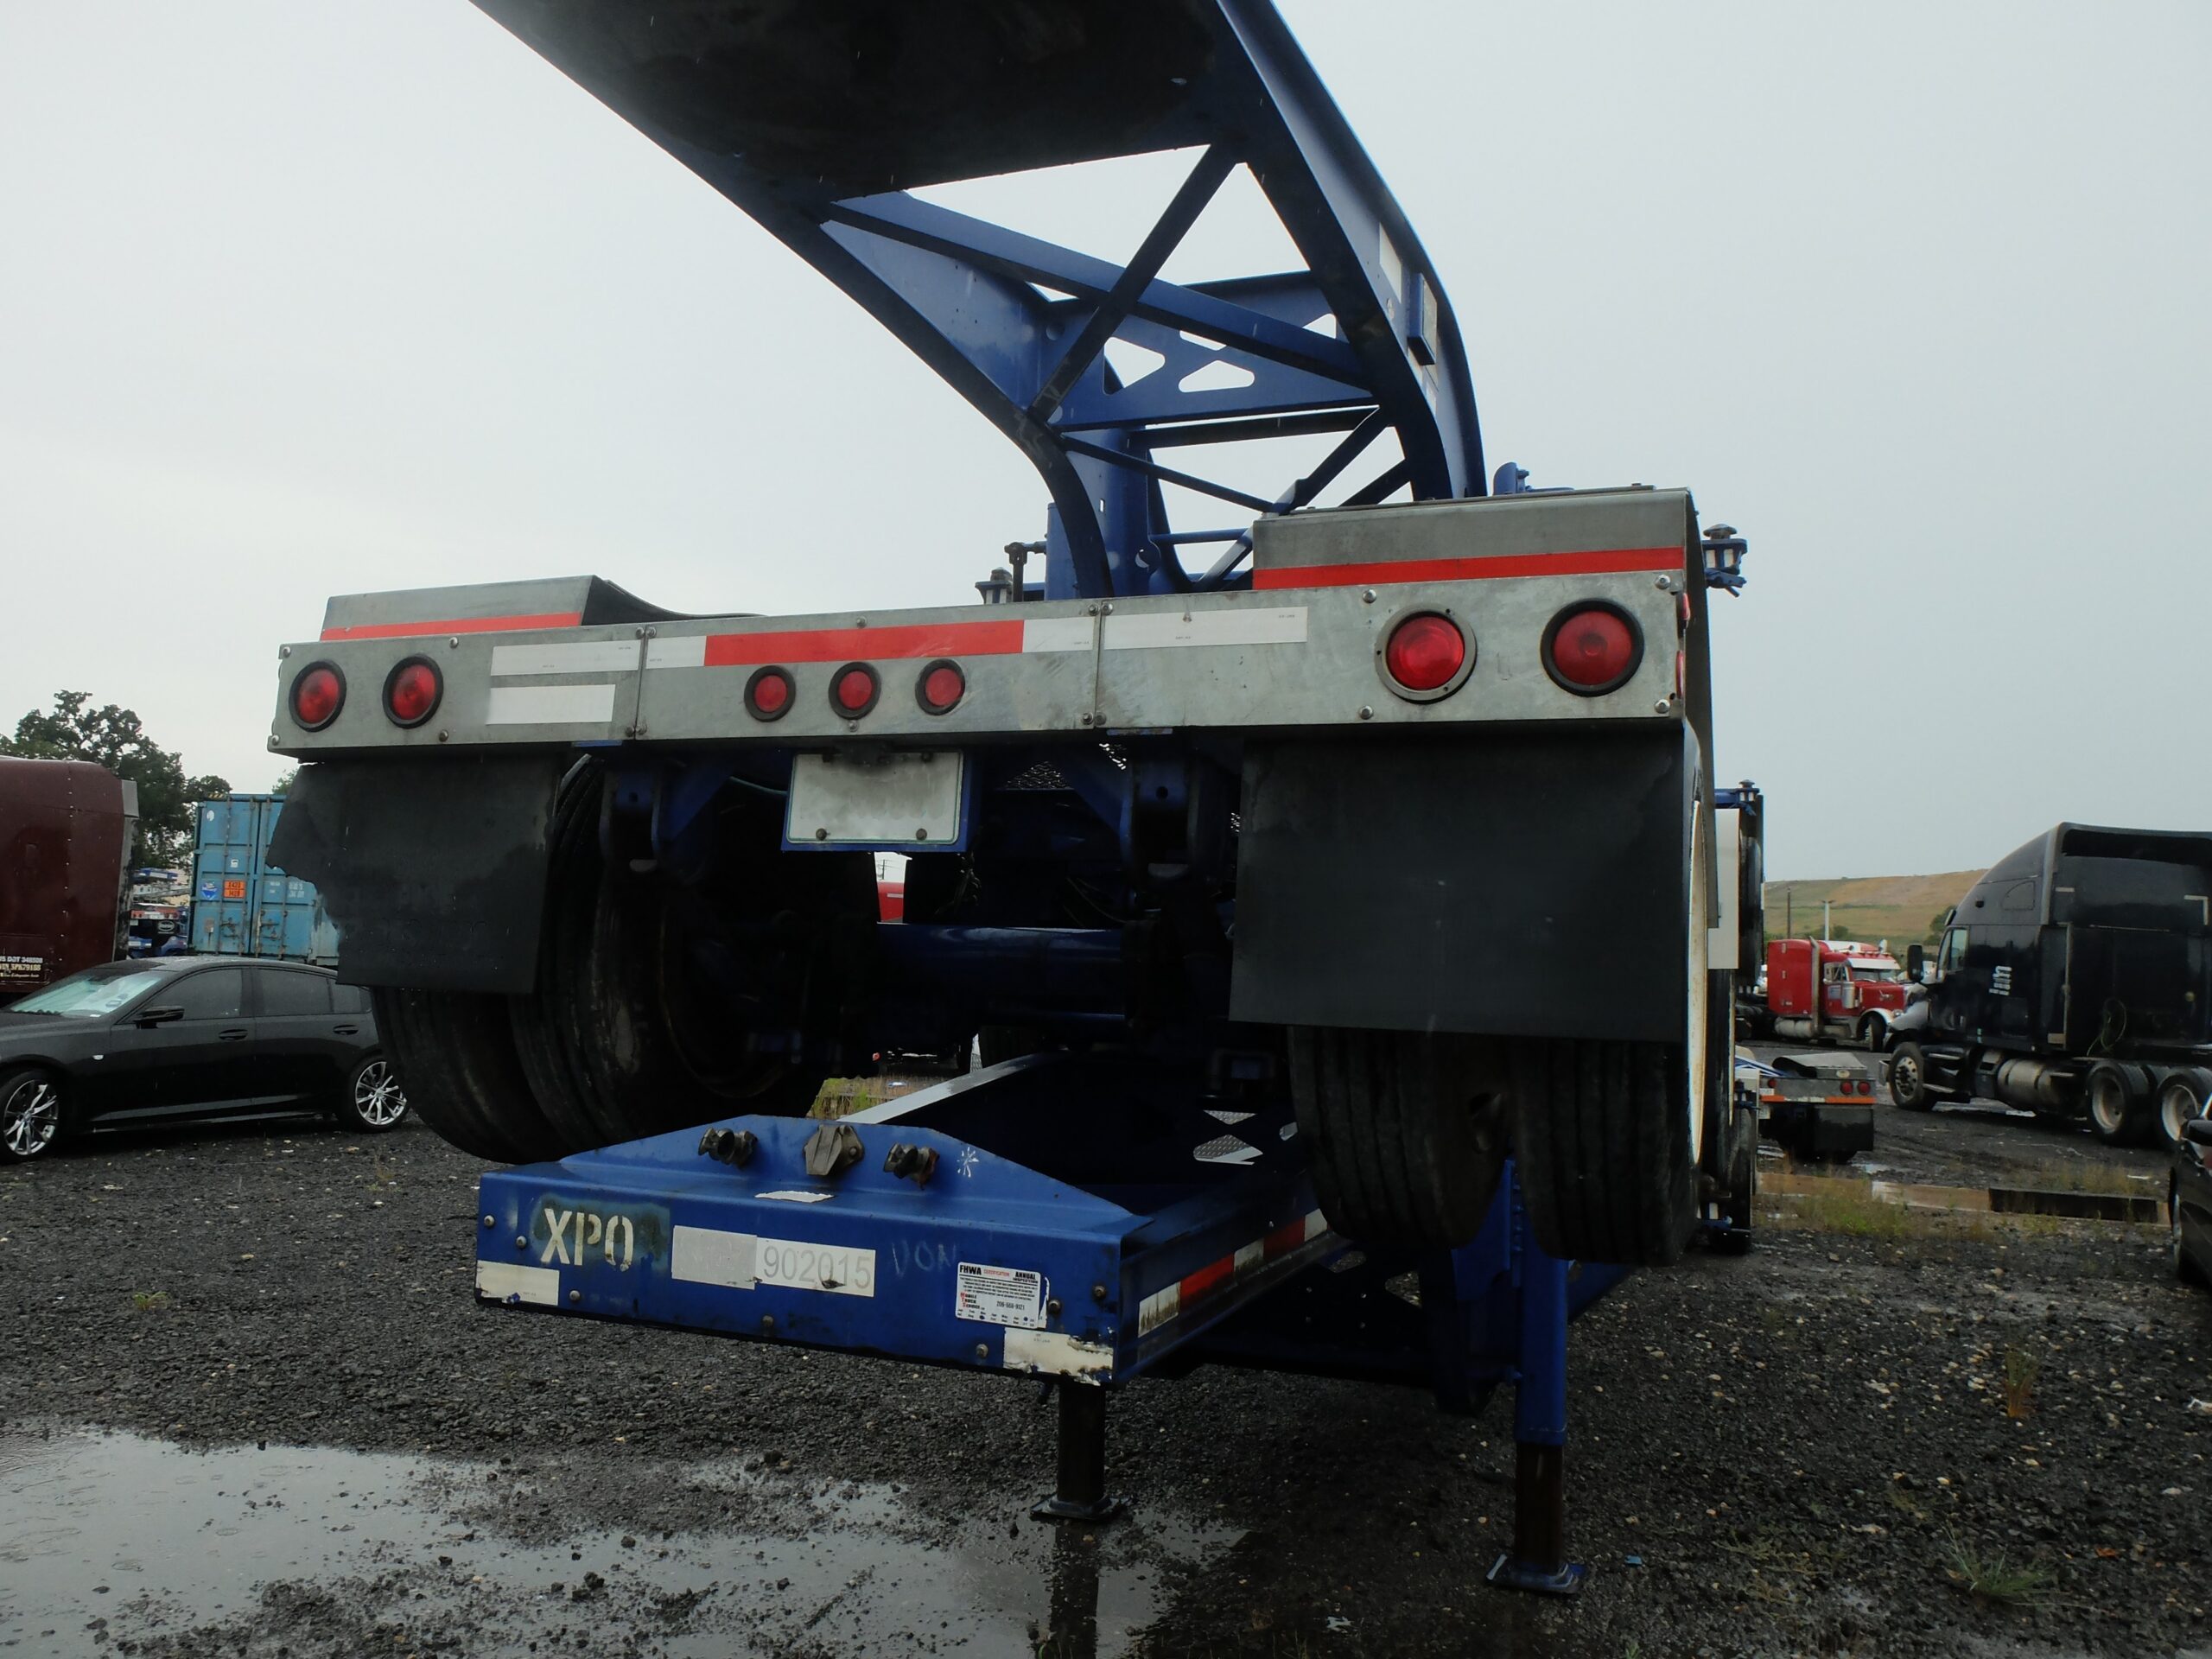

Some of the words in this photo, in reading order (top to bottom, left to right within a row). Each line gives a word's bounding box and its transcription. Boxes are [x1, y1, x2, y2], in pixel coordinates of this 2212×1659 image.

[540, 1208, 634, 1272] XPO
[763, 1246, 871, 1289] 902015
[960, 1265, 982, 1275] FHWA
[1014, 1271, 1036, 1281] ANNUAL
